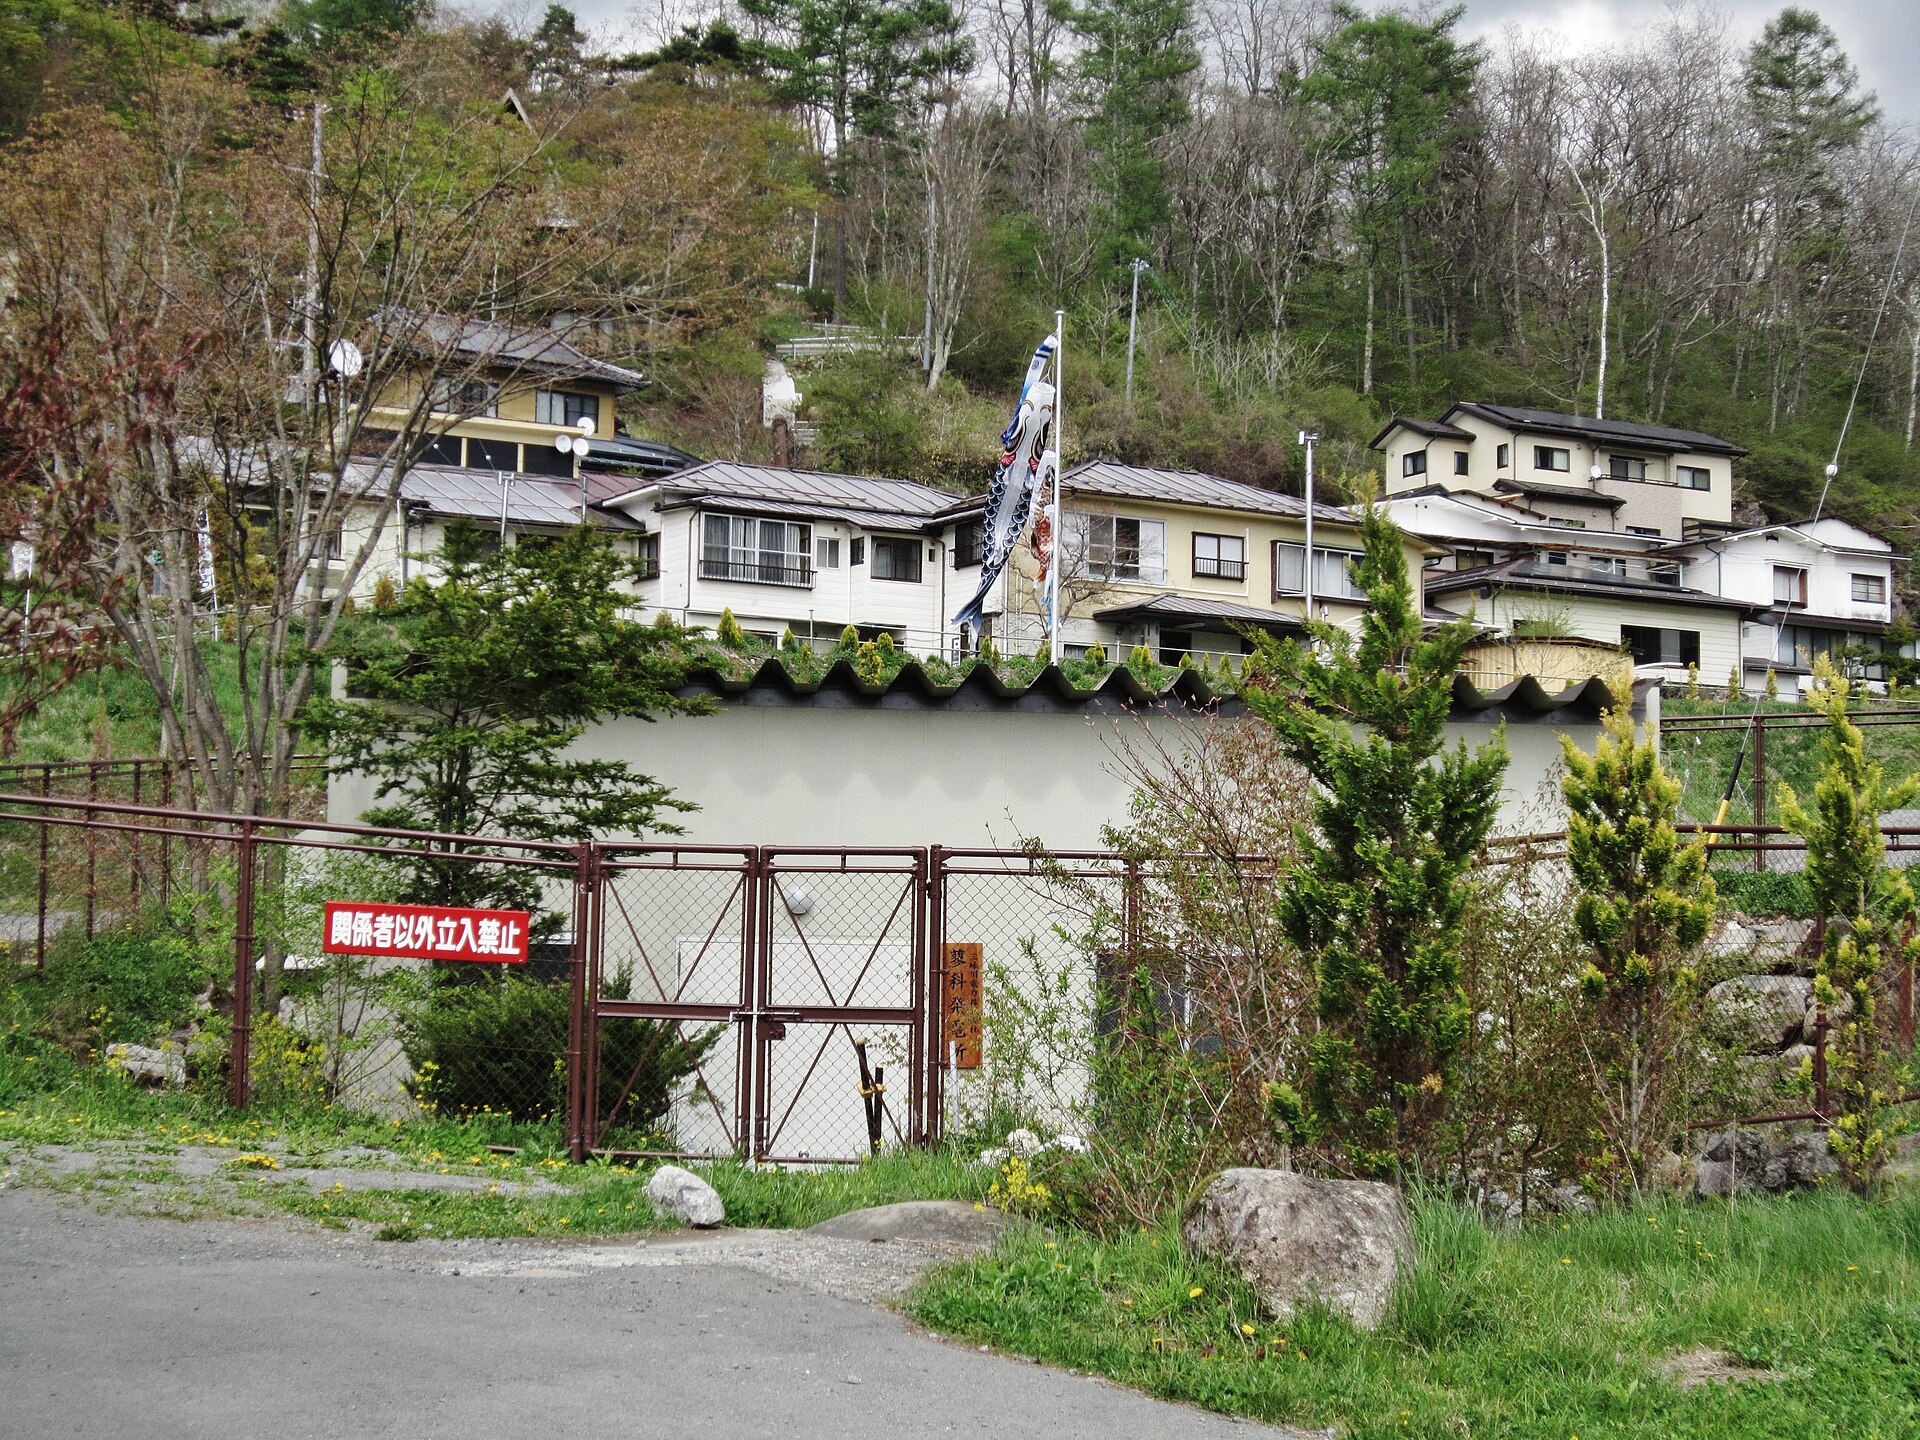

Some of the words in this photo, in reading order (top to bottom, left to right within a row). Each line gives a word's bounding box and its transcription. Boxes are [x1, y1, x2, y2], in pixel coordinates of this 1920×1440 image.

[331, 910, 521, 955] 関係者以外立入禁止
[968, 953, 979, 1034] 三峰川電力株社
